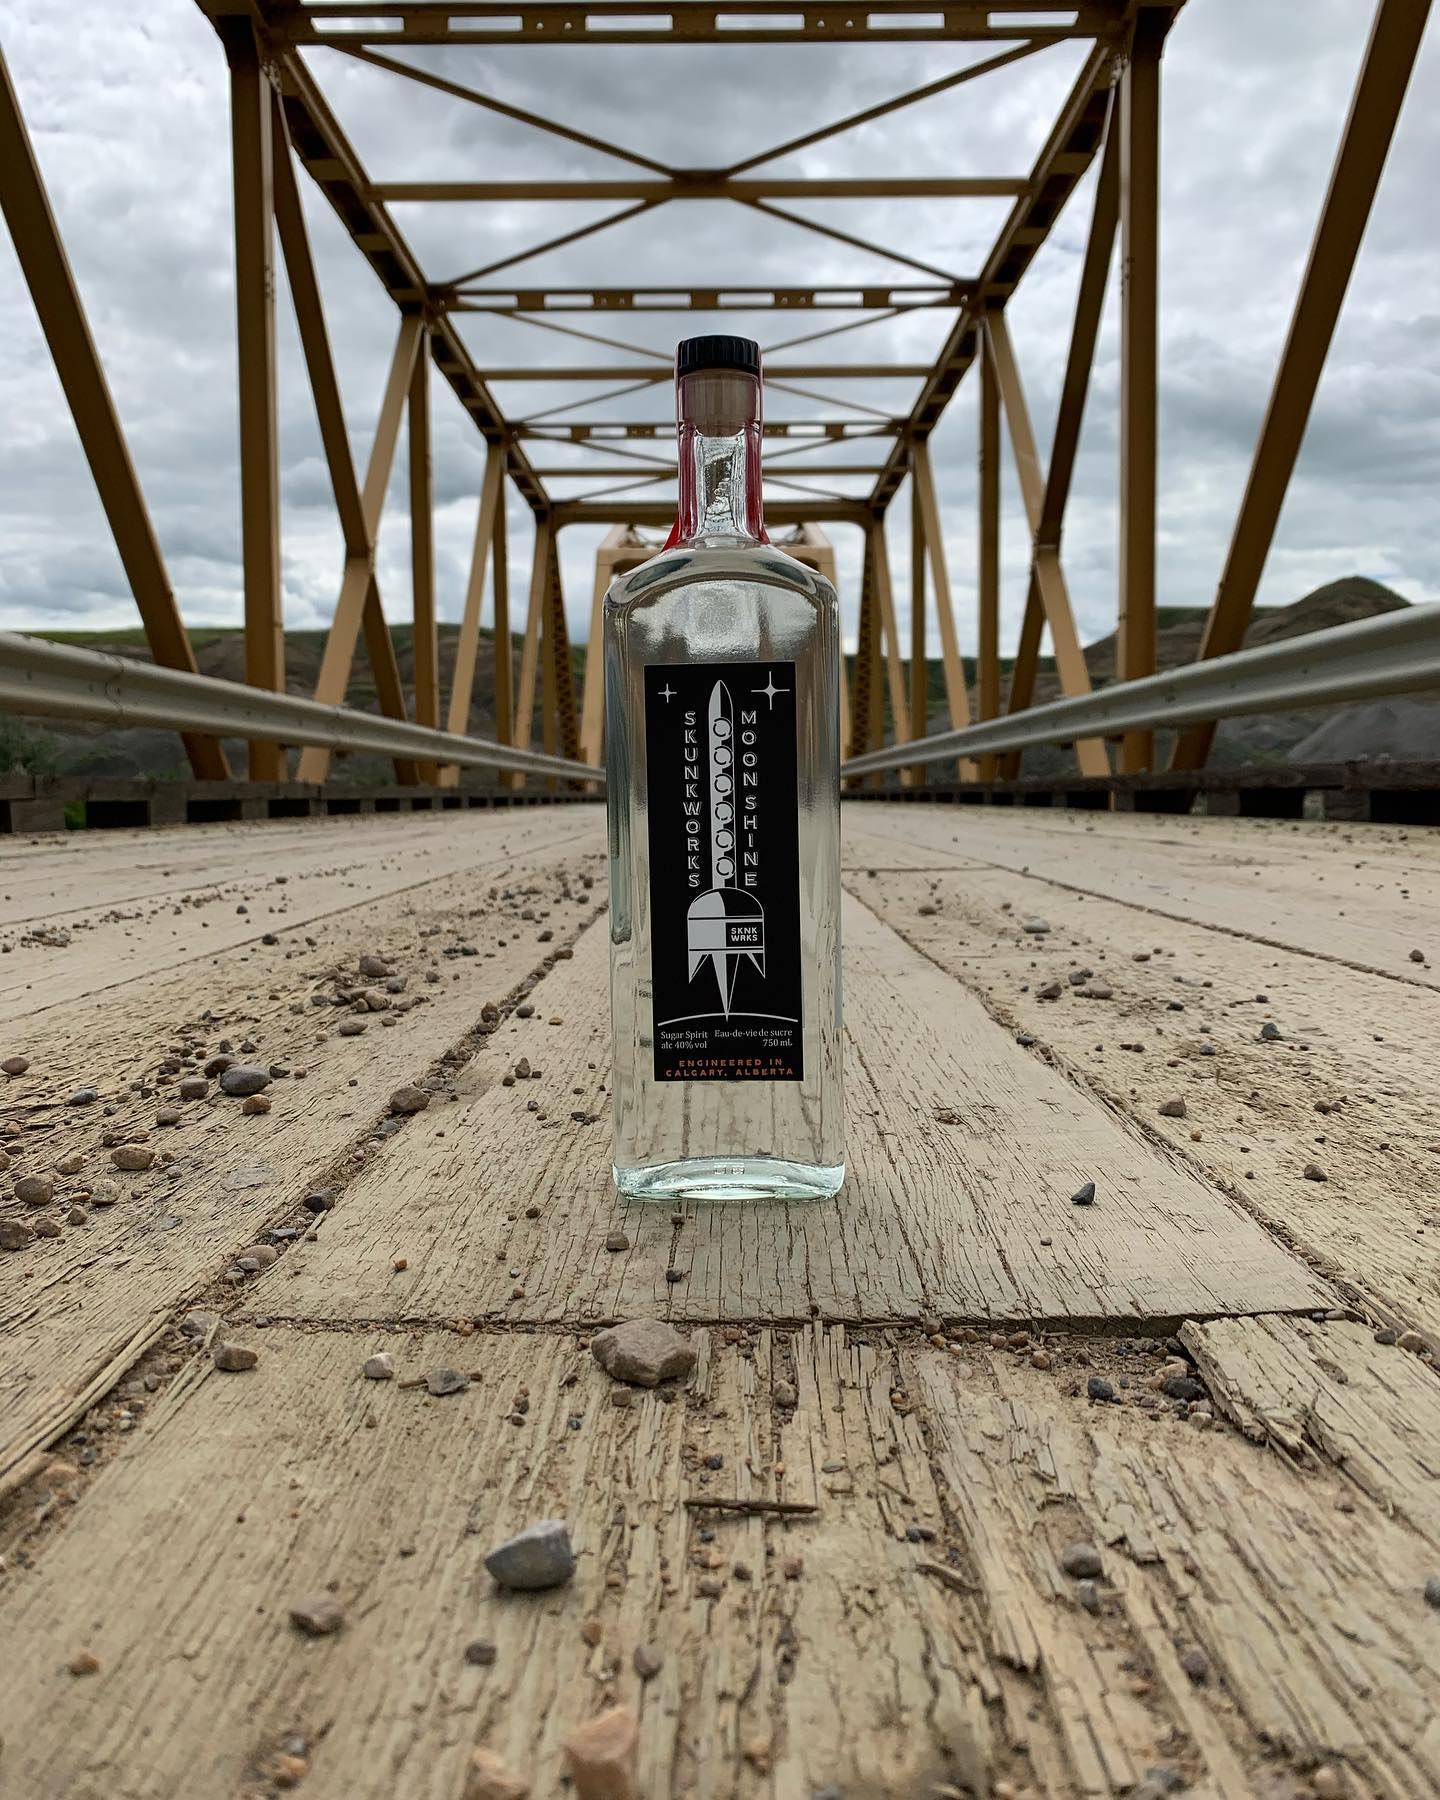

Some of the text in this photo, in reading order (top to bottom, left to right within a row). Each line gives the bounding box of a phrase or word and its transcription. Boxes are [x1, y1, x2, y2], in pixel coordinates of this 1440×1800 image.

[683, 710, 701, 888] SKUNKWORKS
[741, 710, 758, 886] MOONSHINE
[730, 927, 758, 935] SKNK
[730, 934, 758, 942] WRKS
[660, 1030, 708, 1041] Sugar Spirit
[770, 1029, 793, 1037] sucre
[661, 1041, 707, 1050] alc 40% vol
[762, 1038, 779, 1047] 750
[679, 1058, 783, 1067] ENGINEERED IN
[735, 1068, 793, 1076] ALBERTA
